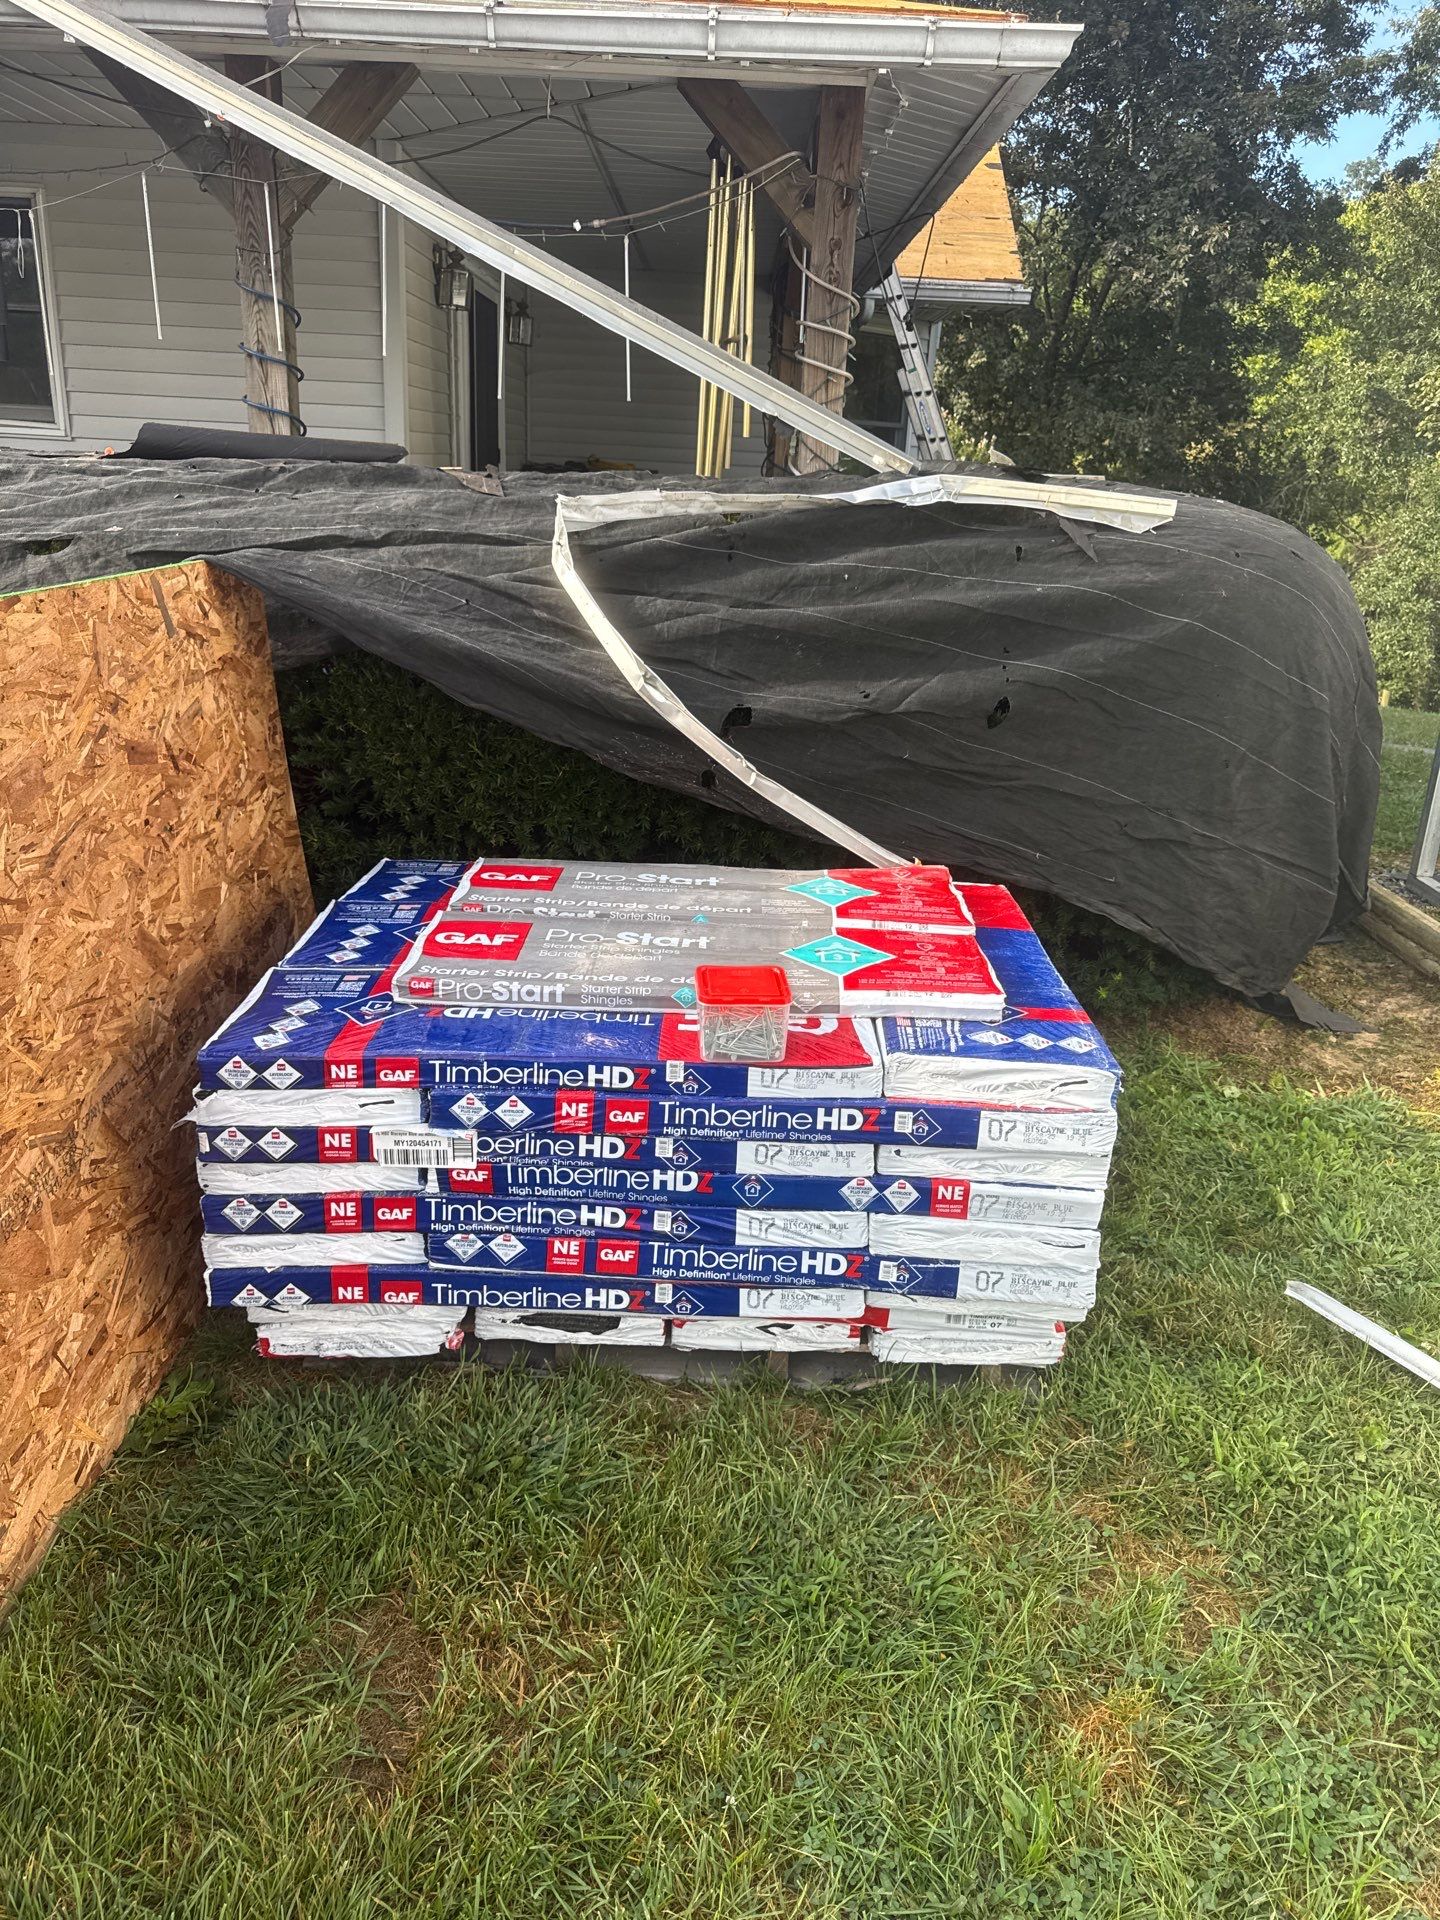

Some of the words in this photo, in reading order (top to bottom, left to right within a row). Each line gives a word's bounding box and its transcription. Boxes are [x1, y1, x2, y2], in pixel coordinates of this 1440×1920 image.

[480, 872, 552, 882] GAF
[575, 871, 719, 887] Pro-Start
[468, 894, 530, 903] Starter
[687, 904, 752, 914] départ
[610, 911, 645, 921] Starter
[647, 912, 671, 922] Strip
[435, 931, 519, 945] GAF
[545, 928, 709, 949] Pro-Start
[539, 950, 586, 959] Bande
[418, 965, 489, 977] Starter
[634, 975, 664, 984] de
[410, 980, 432, 989] GAF
[438, 979, 565, 1003] Pro-Start
[581, 984, 623, 995] Starter
[625, 986, 651, 998] Strip
[581, 994, 633, 1007] Shingles
[497, 1008, 655, 1026] Timberline
[331, 1065, 357, 1079] NE
[380, 1069, 415, 1082] GAF
[429, 1060, 584, 1086] Timberline
[562, 1102, 588, 1117] NE
[609, 1110, 645, 1123] GAF
[659, 1101, 812, 1129] Timberline
[663, 1126, 689, 1137] High
[789, 1131, 832, 1142] Shingles
[988, 1119, 1017, 1141] 07
[1025, 1126, 1066, 1134] BISCAYNE
[325, 1133, 352, 1148] NE
[475, 1133, 575, 1156] berline
[755, 1144, 782, 1165] 07
[790, 1149, 830, 1157] BISCAYNE
[452, 1169, 489, 1182] GAF
[505, 1163, 650, 1190] Timberline
[508, 1187, 531, 1197] High
[628, 1192, 668, 1203] Shingles
[937, 1185, 964, 1200] NE
[331, 1202, 356, 1217] NE
[426, 1198, 576, 1226] Timberline
[970, 1194, 1000, 1217] 07
[1006, 1201, 1048, 1210] BISCAYNE
[1054, 1204, 1074, 1212] BLUE
[377, 1208, 412, 1220] GAF
[431, 1222, 456, 1233] High
[554, 1228, 596, 1238] Shingles
[749, 1217, 776, 1239] 07
[783, 1222, 823, 1230] BISCAYNE
[829, 1222, 849, 1230] BLUE
[554, 1240, 580, 1255] NE
[600, 1249, 635, 1262] GAF
[649, 1242, 798, 1273] Timberline
[652, 1267, 677, 1279] High
[774, 1274, 816, 1286] Shingles
[976, 1271, 1004, 1292] 07
[1011, 1278, 1052, 1286] BISCAYNE
[338, 1287, 363, 1299] NE
[384, 1291, 418, 1303] GAF
[431, 1283, 581, 1308] Timberline
